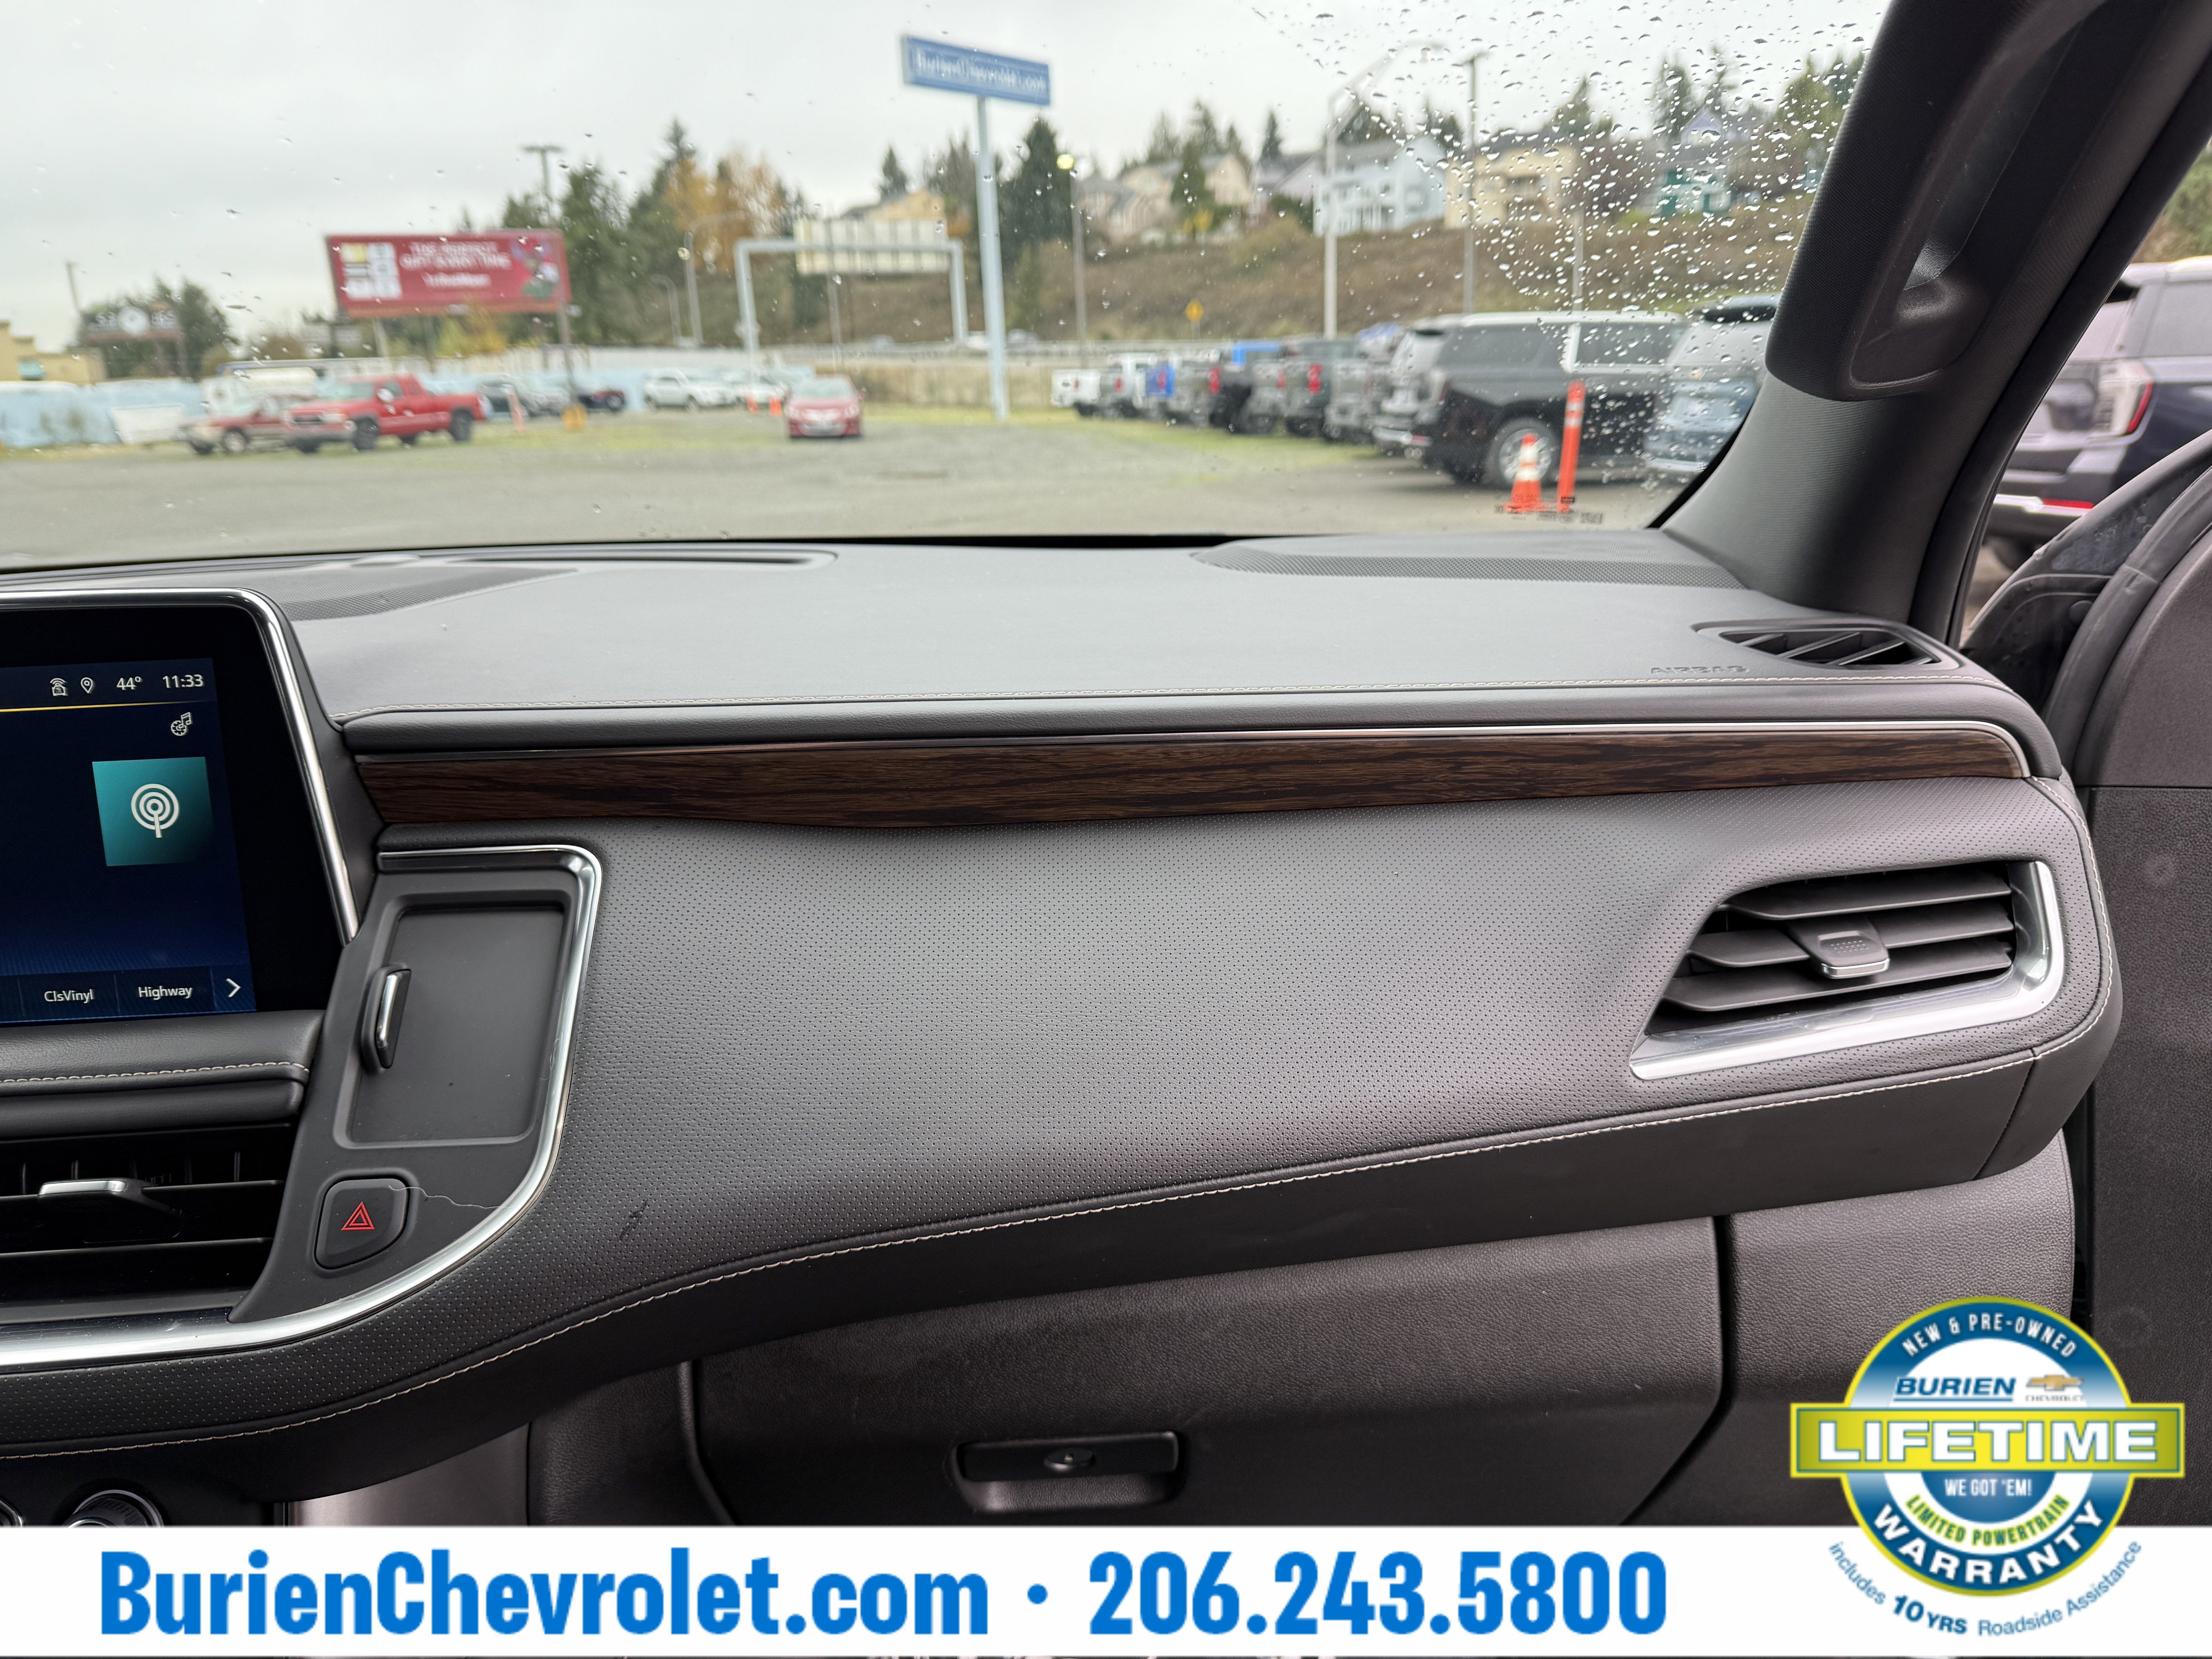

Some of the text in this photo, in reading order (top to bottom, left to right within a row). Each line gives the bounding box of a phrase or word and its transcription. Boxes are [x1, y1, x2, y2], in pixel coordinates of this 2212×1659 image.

[117, 674, 204, 690] 44° 11:33
[44, 989, 93, 1004] ClsVinyl
[138, 985, 192, 1000] Highway
